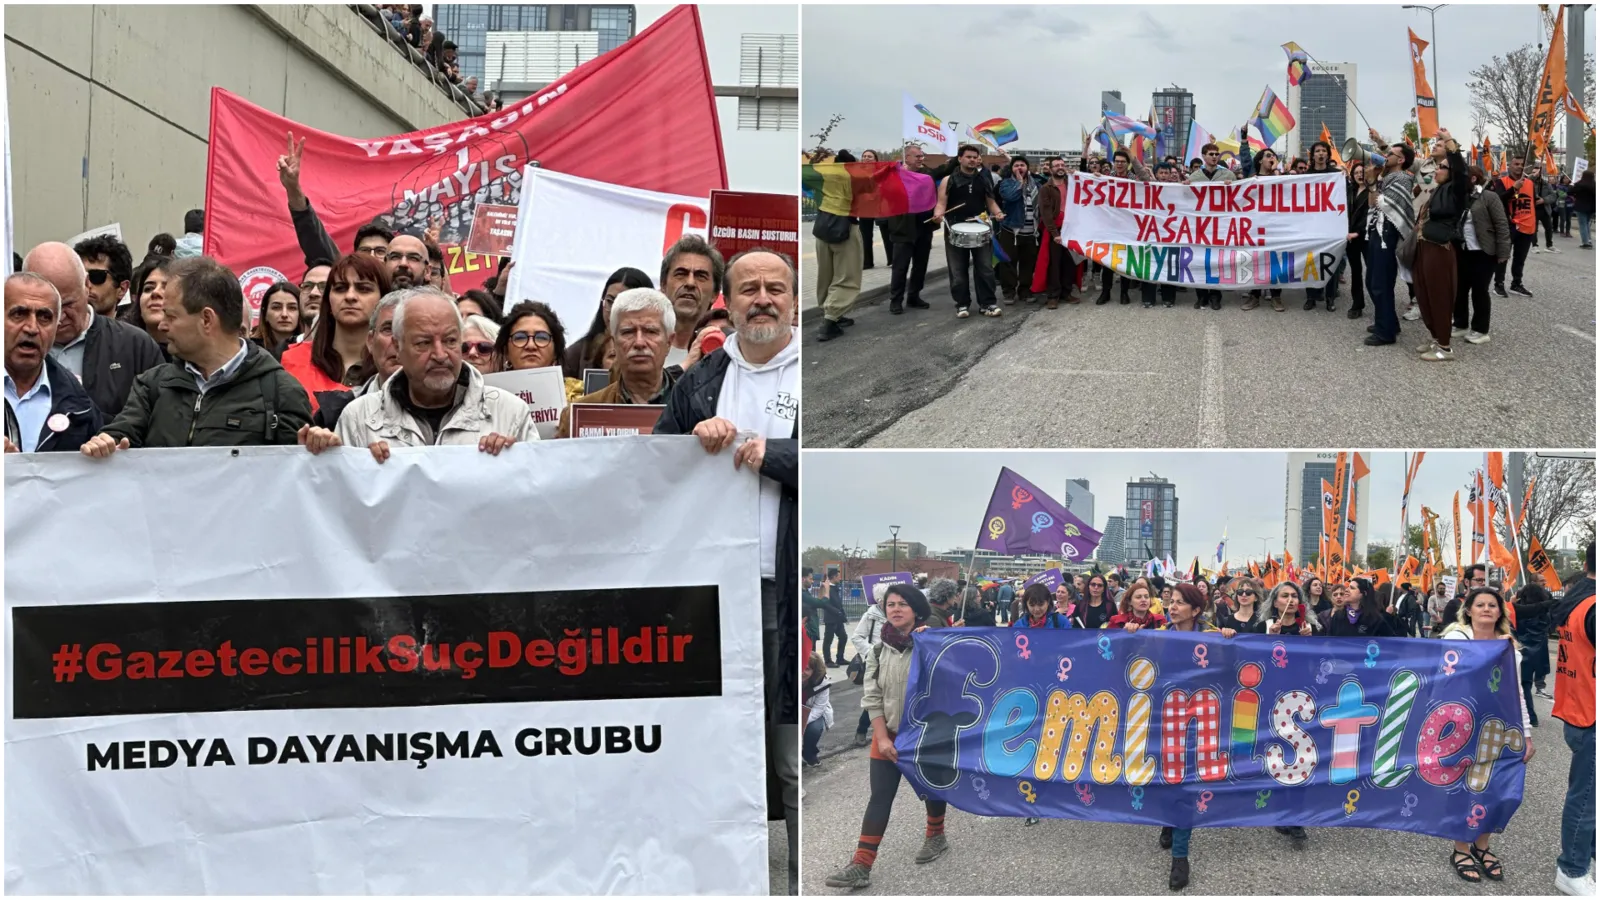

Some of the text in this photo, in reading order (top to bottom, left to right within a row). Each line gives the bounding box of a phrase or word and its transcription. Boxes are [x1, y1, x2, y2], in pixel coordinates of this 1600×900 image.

[1191, 181, 1346, 216] YOKSULLUK,
[713, 225, 798, 242] ÖZGÜR BASIN SUSTURUL
[1205, 247, 1336, 284] LUBUNLAR
[515, 389, 535, 405] ĞİL
[530, 406, 558, 423] ERİYİZ
[52, 626, 693, 682] #GazetecilikSuçDeğildir
[87, 724, 663, 771] MEDYA DAYANIŞMA GRUBU
